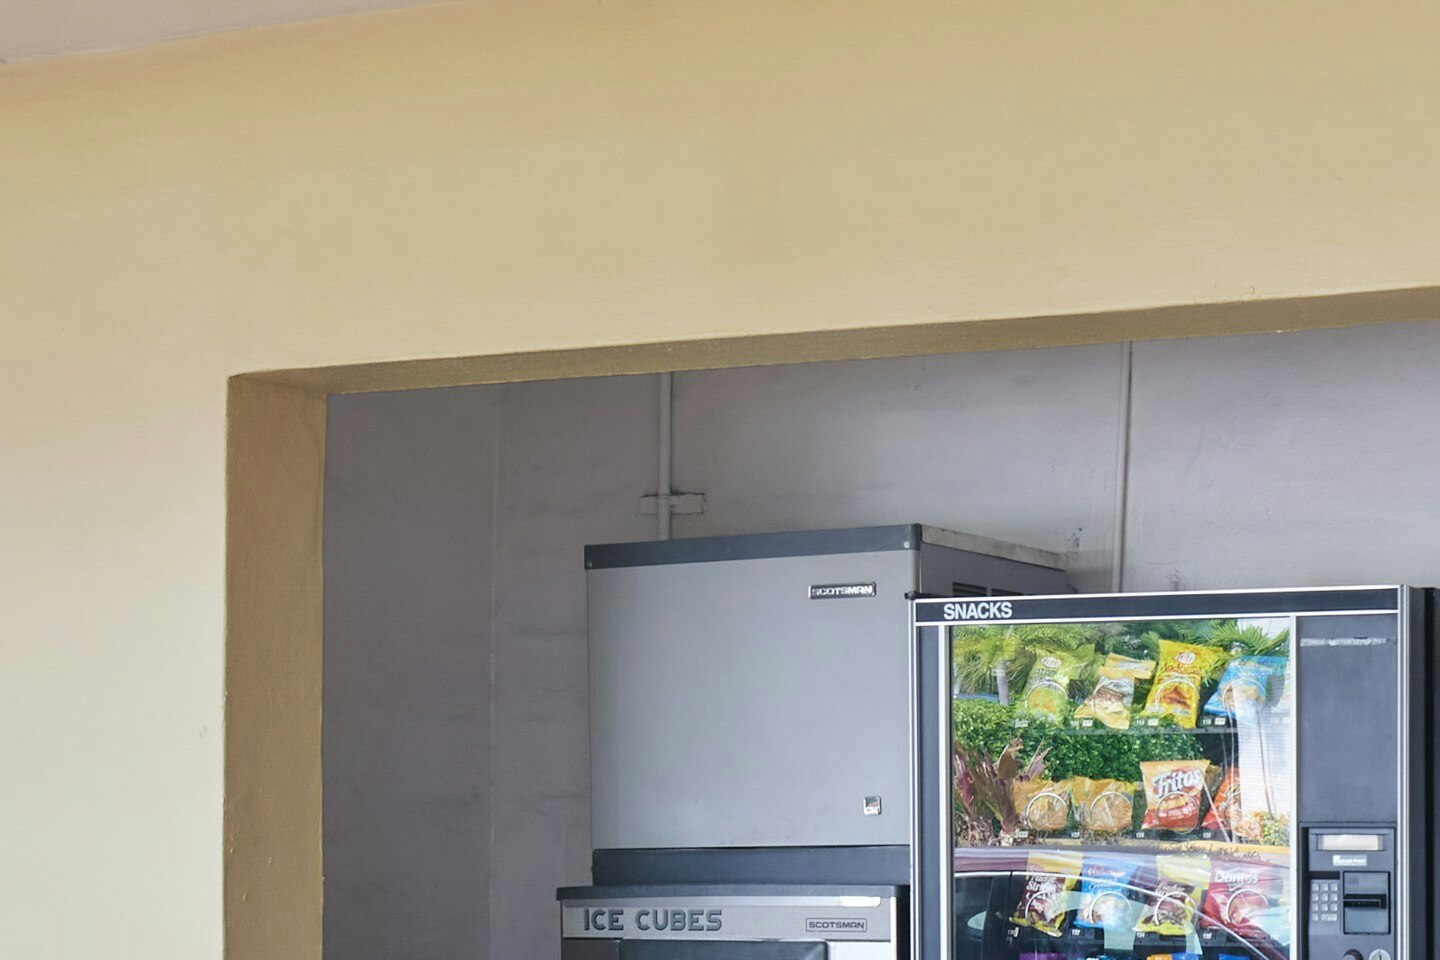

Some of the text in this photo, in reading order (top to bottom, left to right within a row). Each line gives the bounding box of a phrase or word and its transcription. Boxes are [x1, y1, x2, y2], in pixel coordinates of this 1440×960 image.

[811, 585, 873, 596] SCOTSMAN
[943, 602, 1013, 620] SNACKS
[1152, 769, 1202, 798] Fritos
[1214, 868, 1259, 884] Doritos
[583, 909, 723, 932] ICE CUBES
[808, 921, 865, 930] SCOTSMAN
